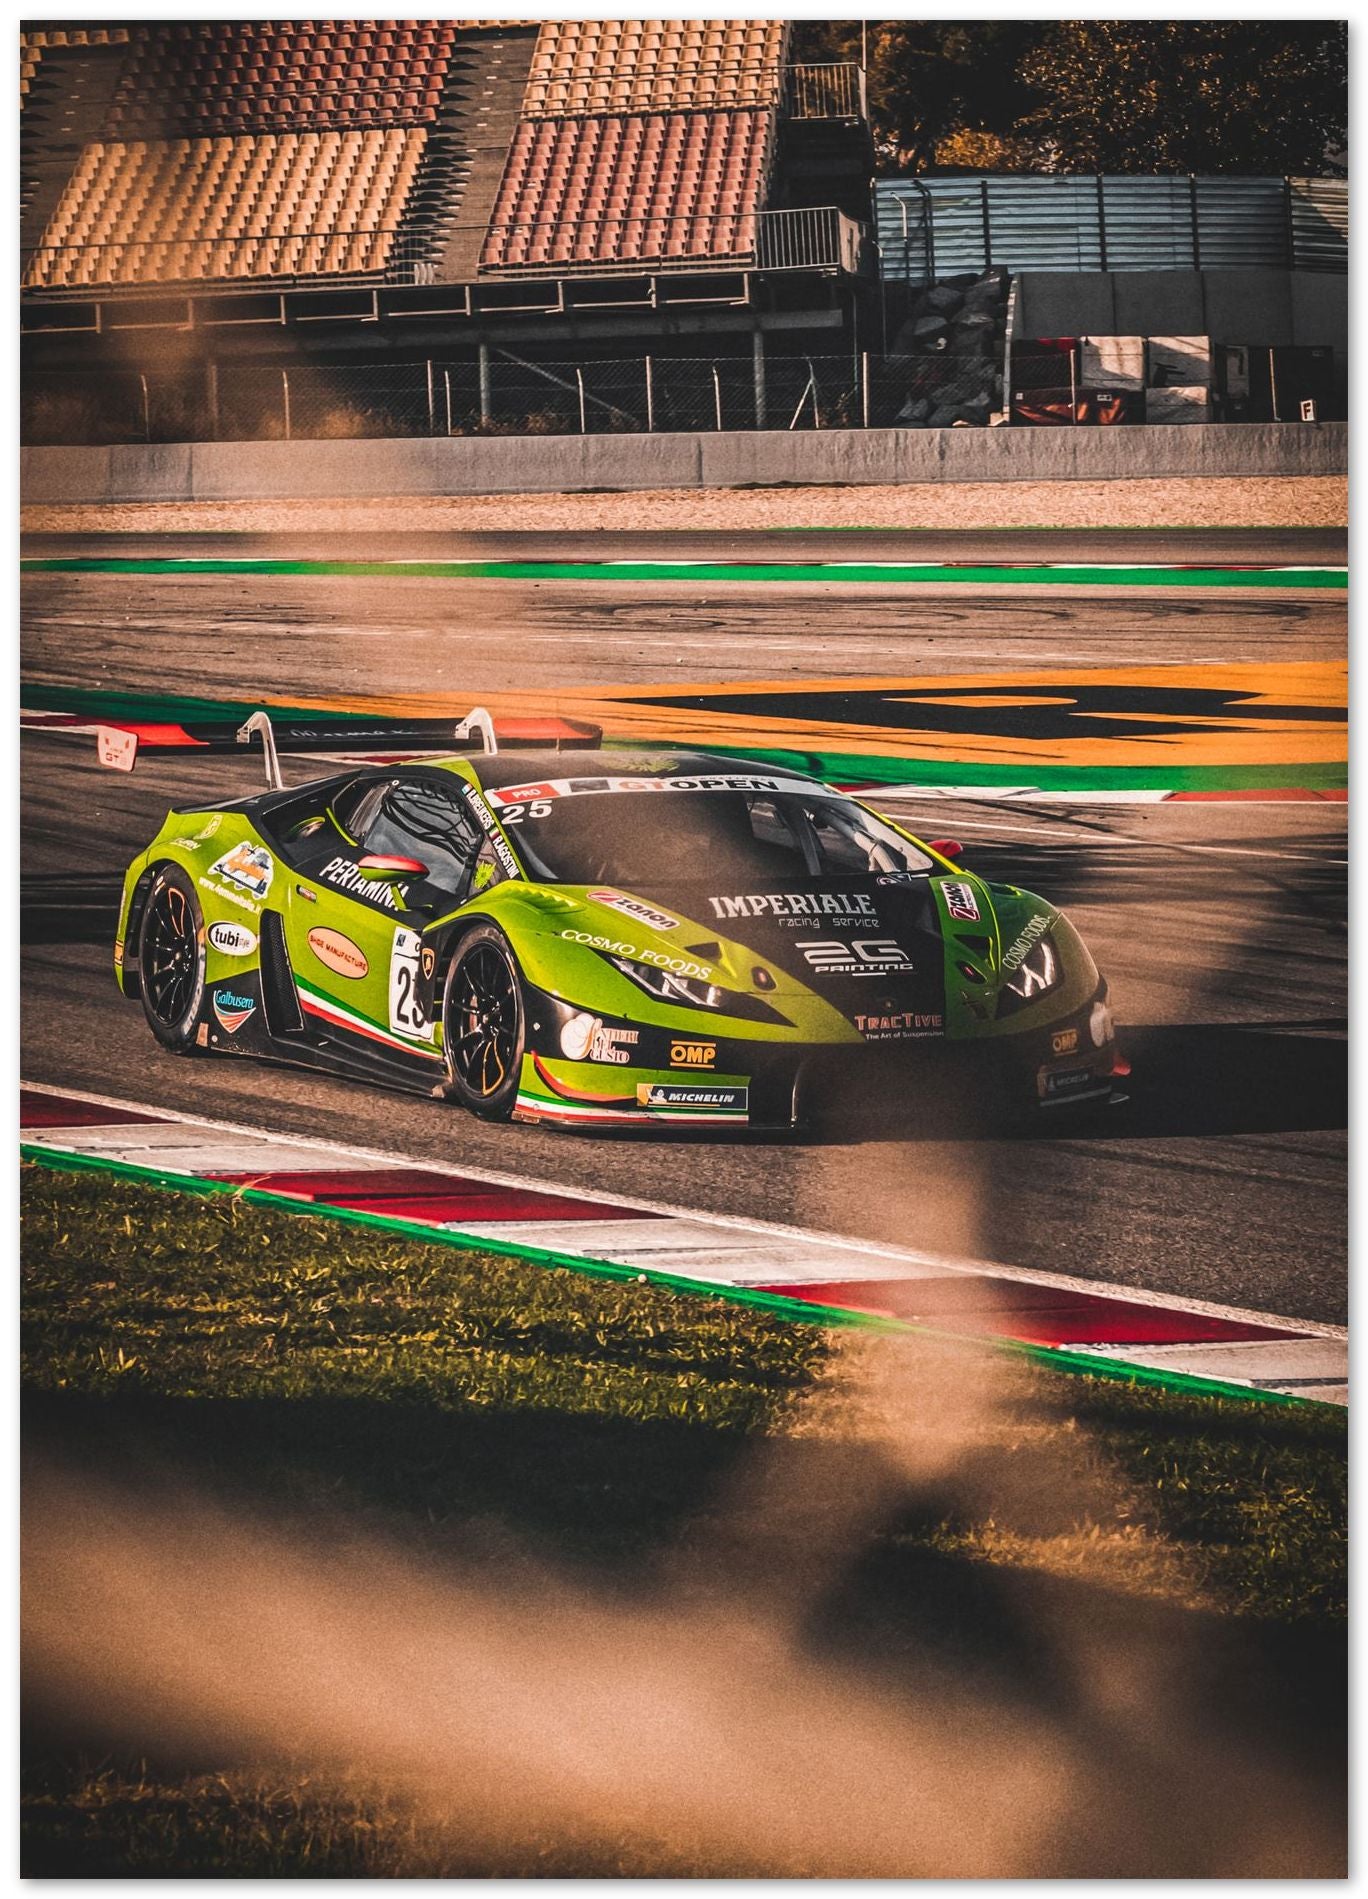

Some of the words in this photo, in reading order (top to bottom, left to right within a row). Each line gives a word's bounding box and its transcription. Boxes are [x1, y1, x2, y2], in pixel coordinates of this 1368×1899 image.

[1302, 402, 1312, 420] F
[511, 788, 542, 799] PRO
[501, 799, 553, 825] 25
[616, 898, 678, 928] zanon
[708, 894, 877, 919] IMPERIALE
[778, 916, 821, 929] racing
[832, 917, 880, 928] service
[215, 927, 240, 947] tubi
[561, 929, 636, 955] COSMO
[638, 949, 713, 980] FOODS
[794, 939, 910, 965] 2G
[1002, 937, 1033, 970] COSMO
[814, 963, 914, 973] PAINTING
[1052, 1032, 1078, 1052] OMP
[670, 1046, 717, 1064] OMP
[668, 1092, 735, 1103] MICHELIN
